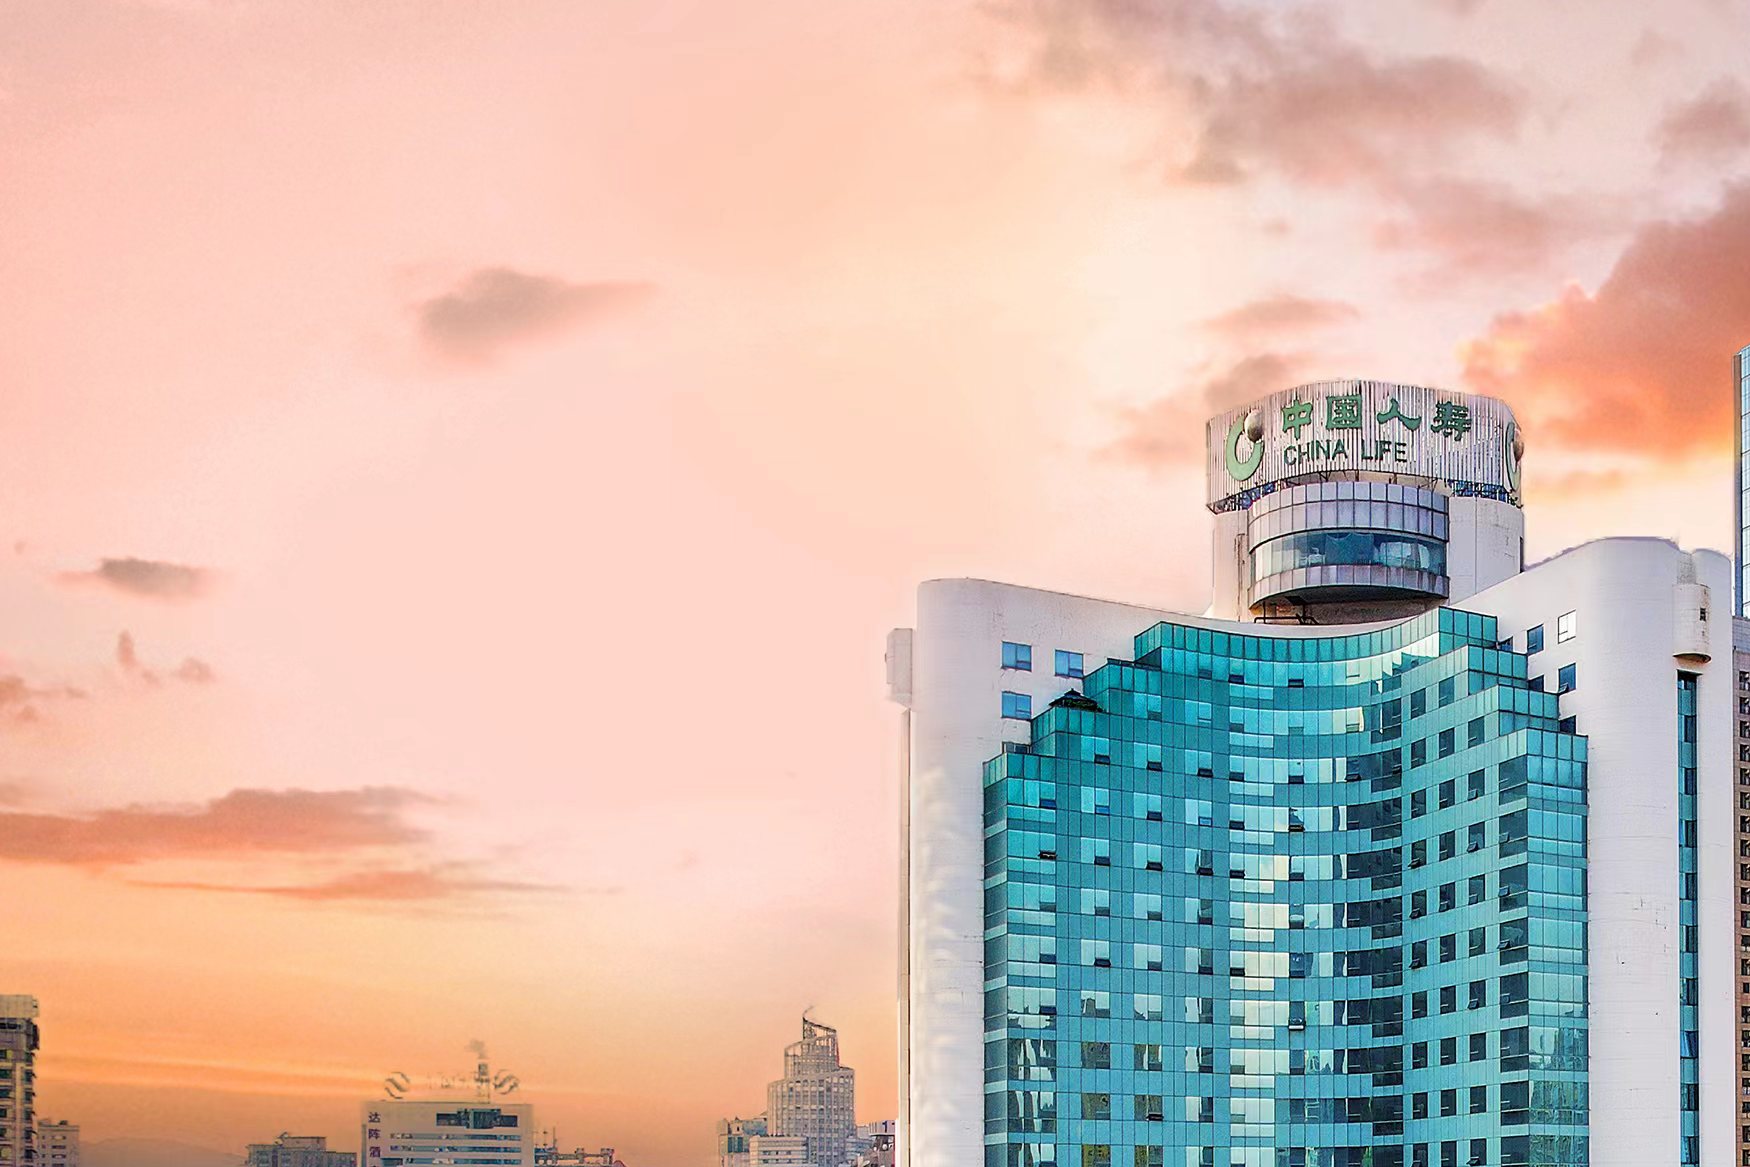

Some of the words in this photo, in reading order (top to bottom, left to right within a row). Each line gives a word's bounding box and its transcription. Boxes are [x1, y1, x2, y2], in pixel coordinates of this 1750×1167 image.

[1280, 394, 1473, 442] 中国人寿
[1283, 438, 1349, 467] CHINA
[1361, 438, 1408, 464] LIFE
